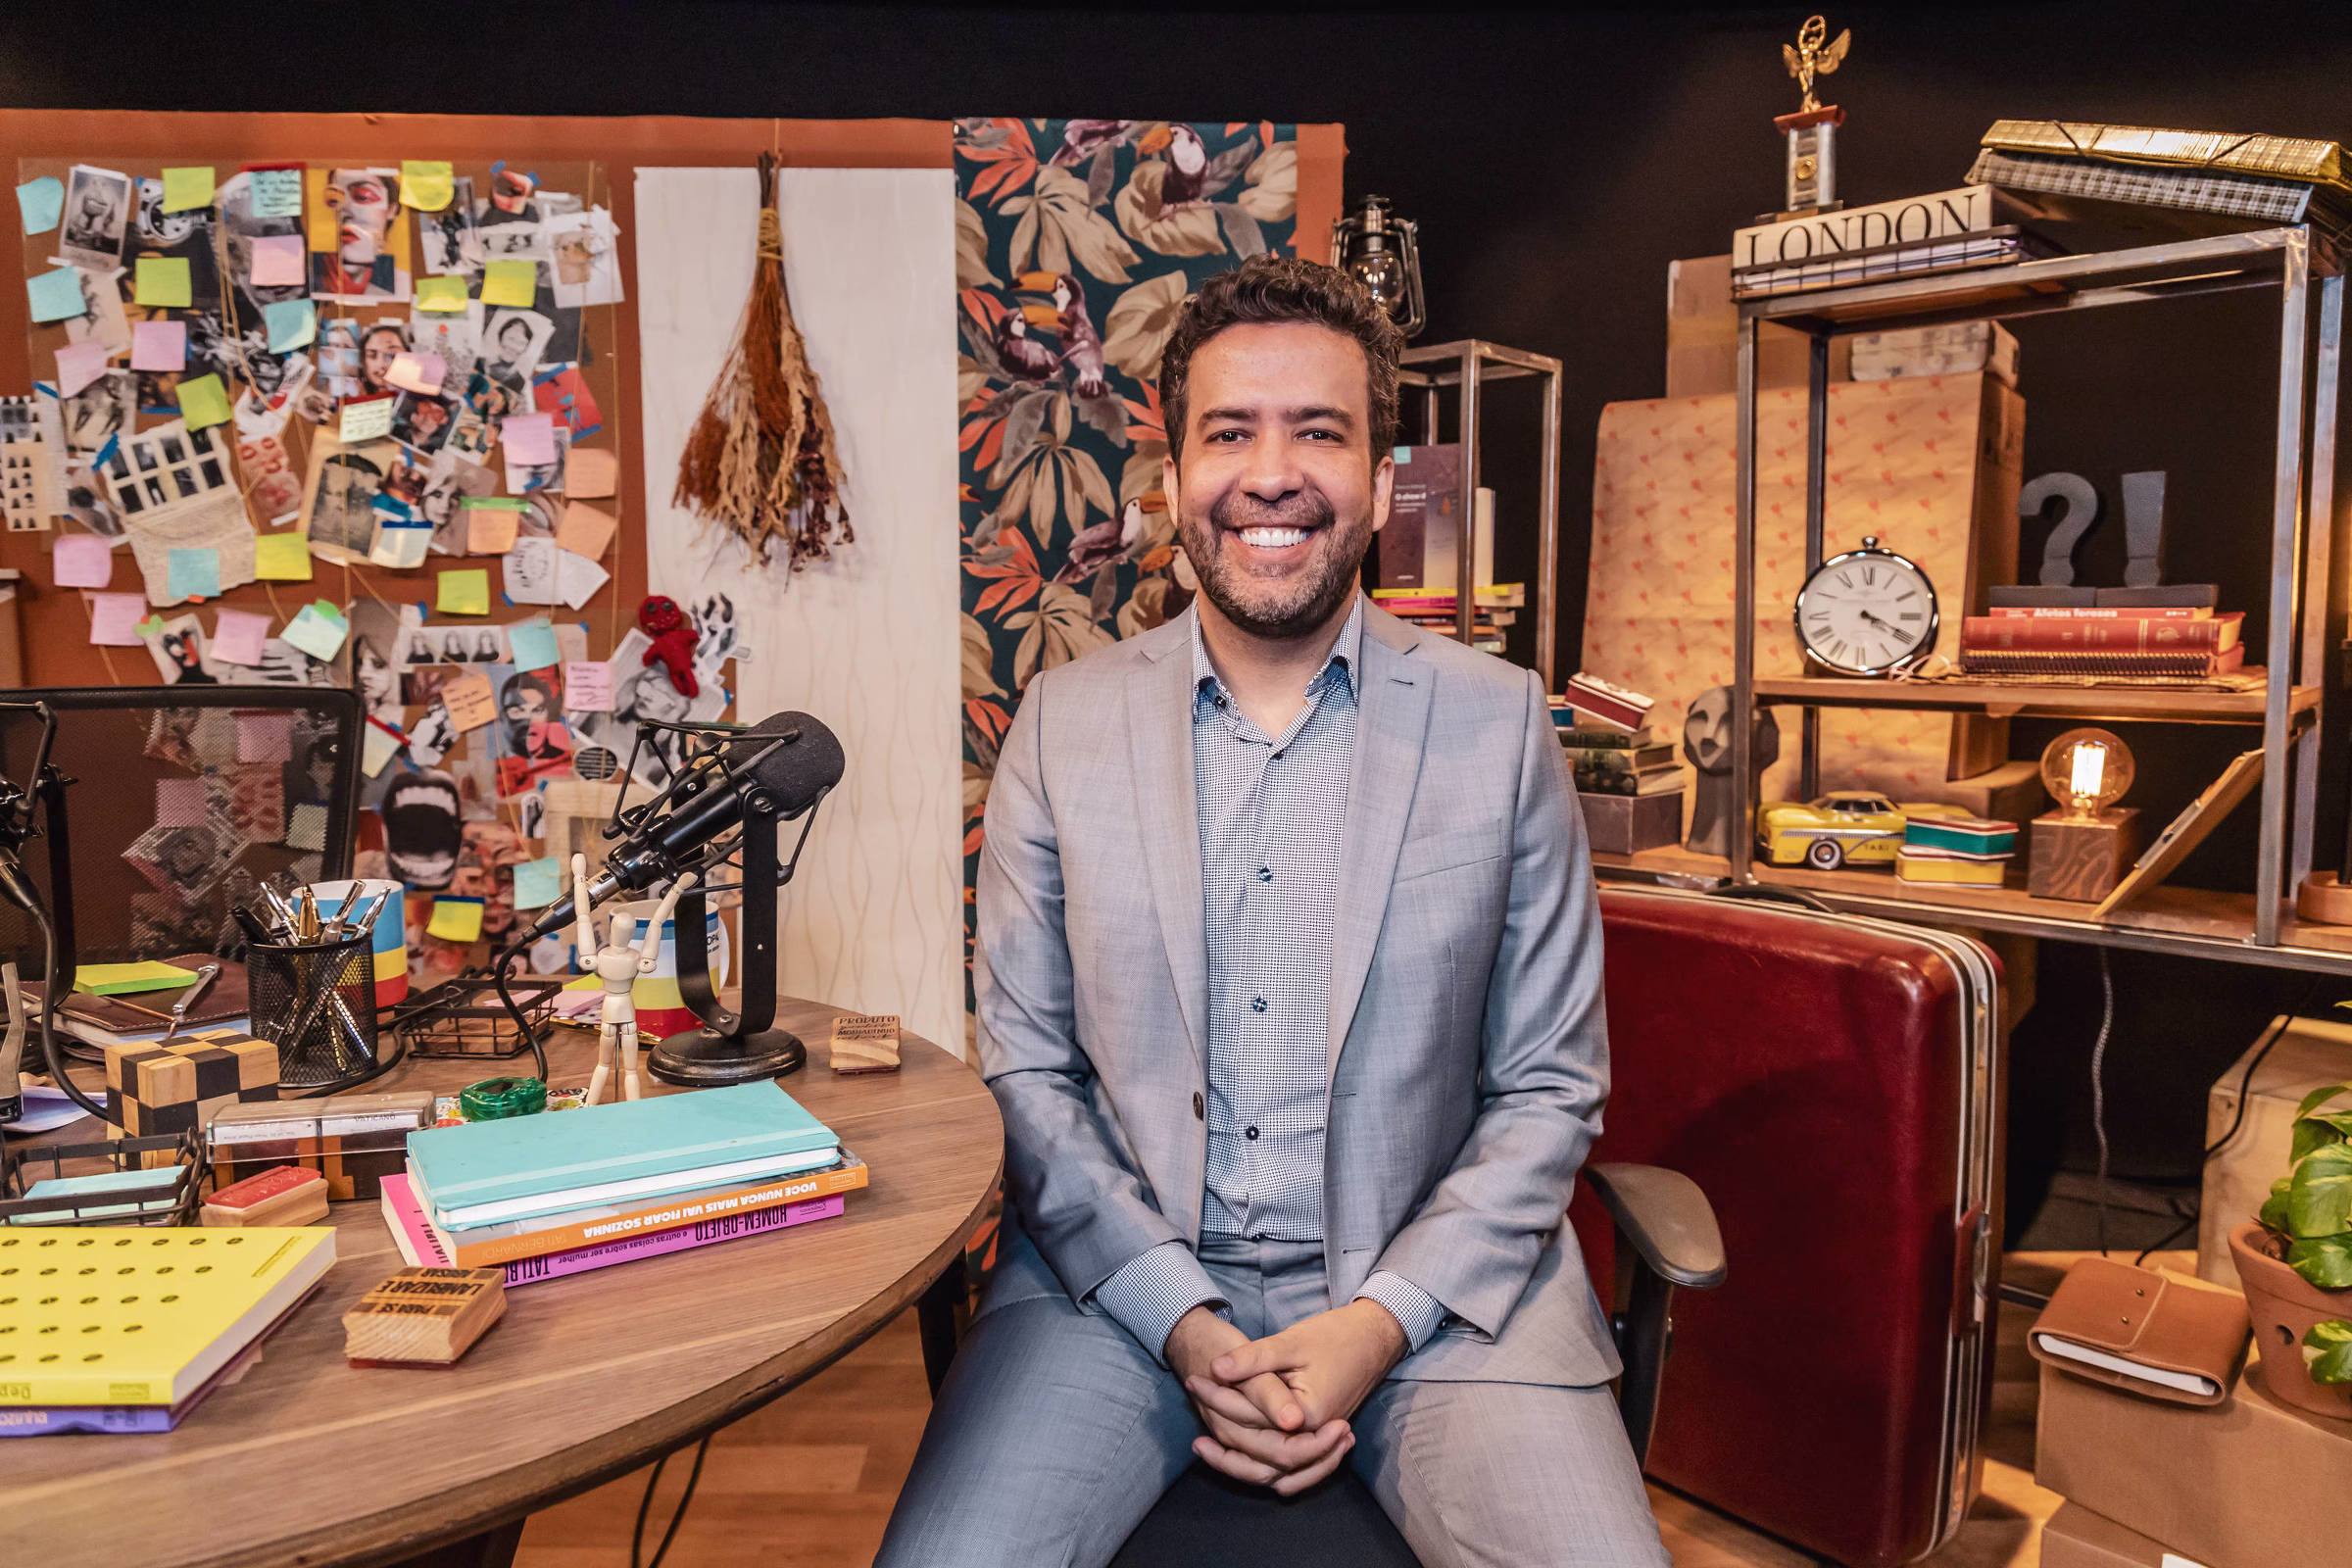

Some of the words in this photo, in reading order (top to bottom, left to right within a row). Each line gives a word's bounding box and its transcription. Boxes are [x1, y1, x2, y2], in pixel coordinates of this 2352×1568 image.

[1746, 192, 1978, 270] LONDON
[740, 1189, 783, 1205] NUNCA
[682, 1205, 704, 1218] VAI
[706, 1198, 738, 1213] MAIS
[583, 1217, 642, 1238] SOZINHA
[695, 1204, 788, 1242] HOMEM-OBJETO
[629, 1239, 655, 1249] coisas
[656, 1233, 681, 1244] outras
[605, 1244, 628, 1254] sobre
[559, 1251, 589, 1264] mulher
[522, 1253, 551, 1280] TATI
